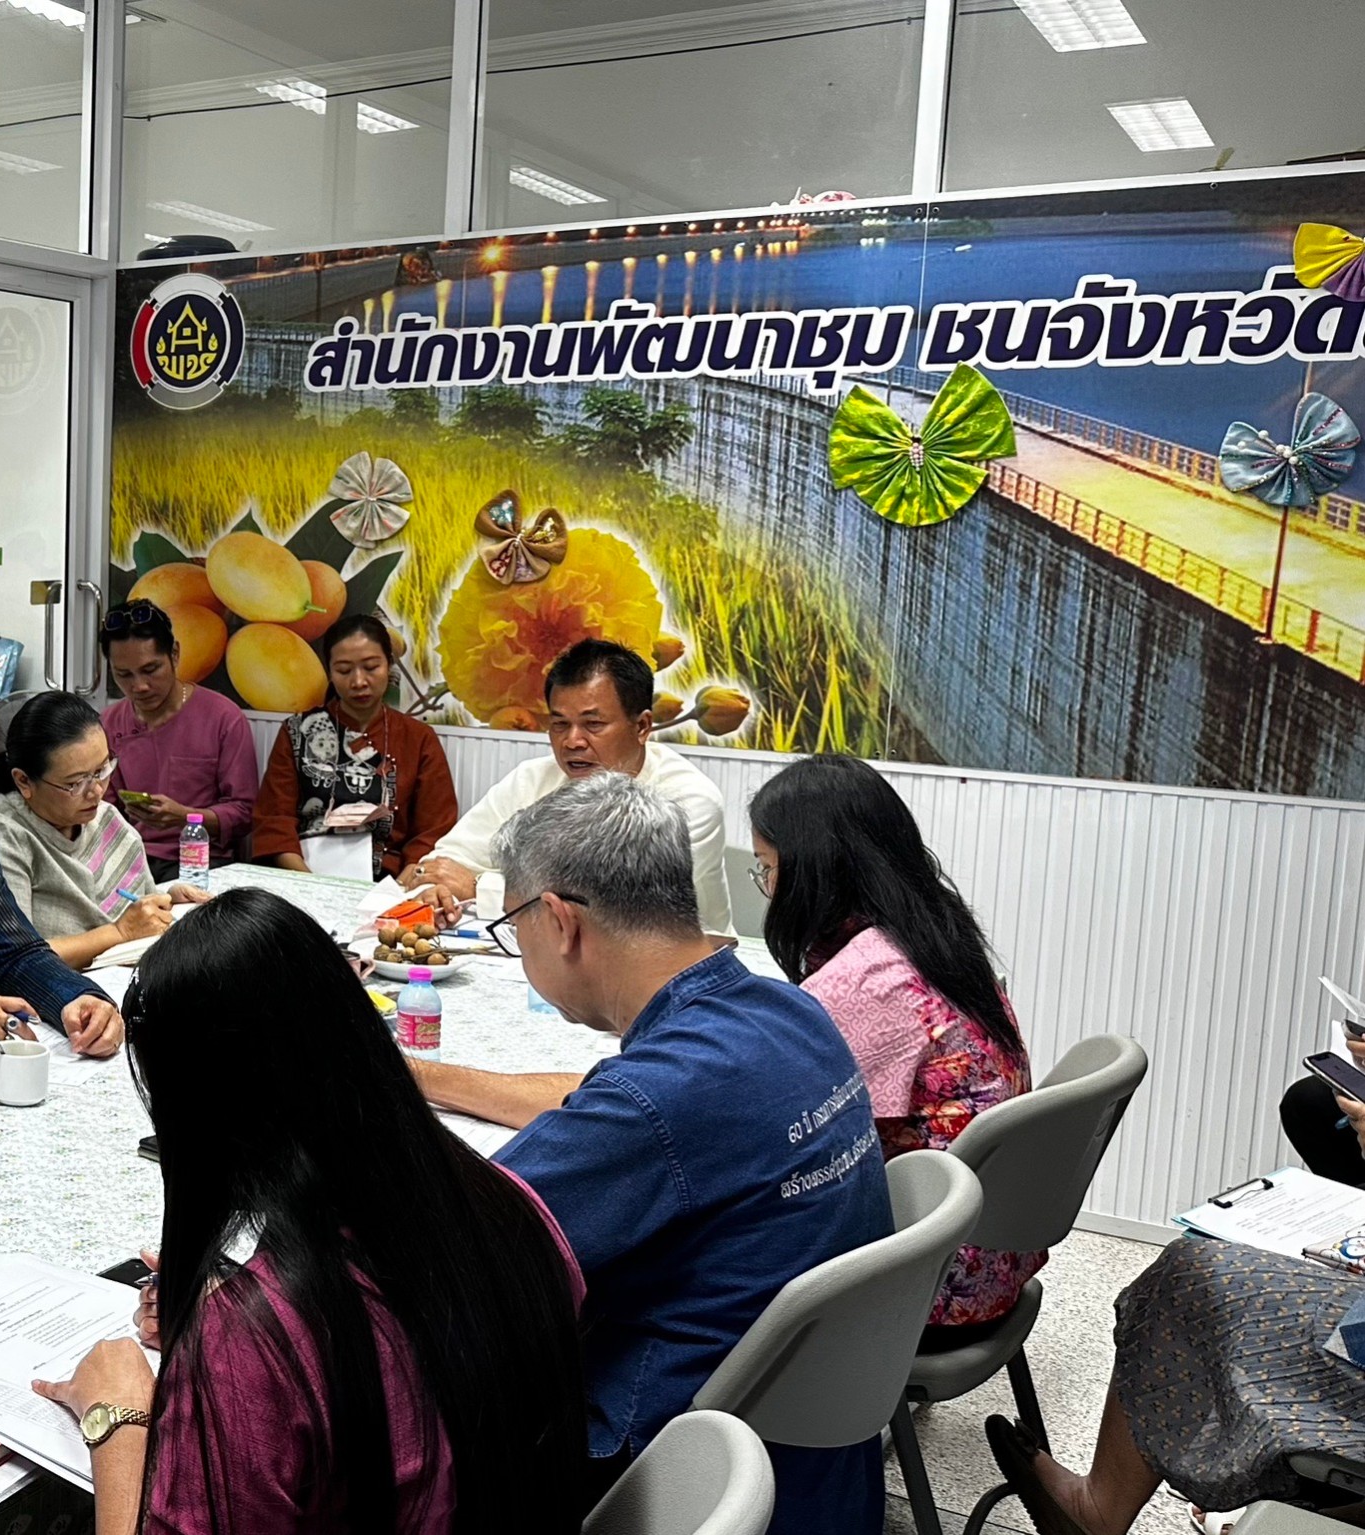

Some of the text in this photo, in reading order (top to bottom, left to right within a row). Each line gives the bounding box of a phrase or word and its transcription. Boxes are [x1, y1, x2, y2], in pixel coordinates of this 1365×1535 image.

[310, 304, 906, 389] สำนักงานพัฒนาชุม
[788, 1122, 803, 1143] 60
